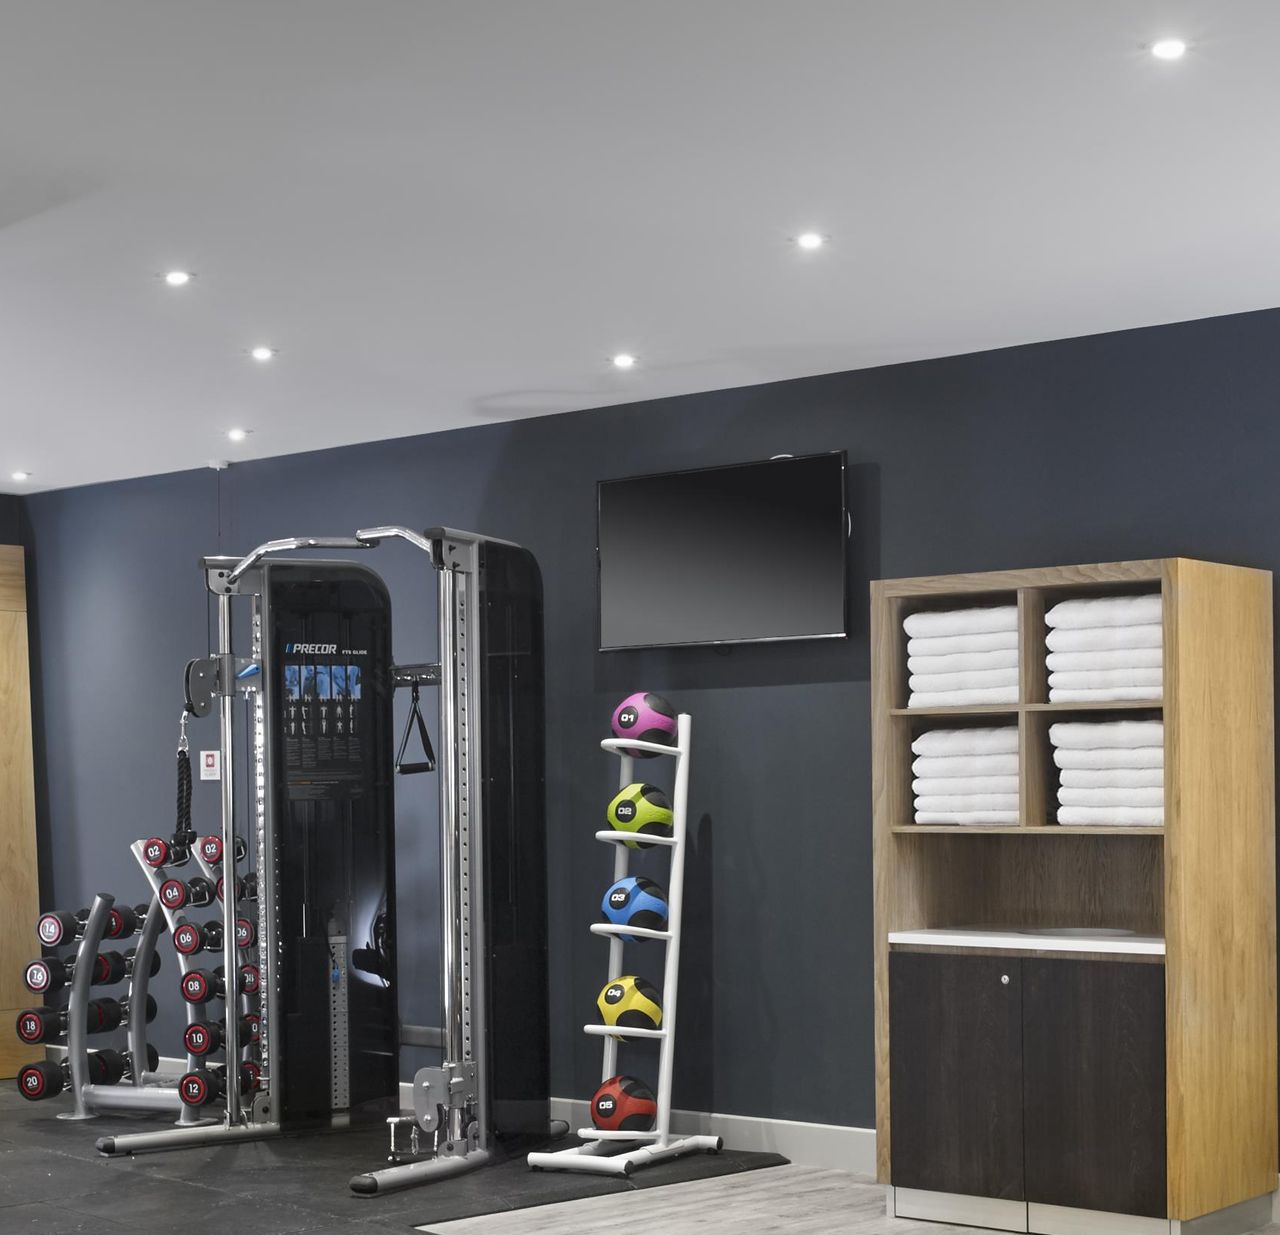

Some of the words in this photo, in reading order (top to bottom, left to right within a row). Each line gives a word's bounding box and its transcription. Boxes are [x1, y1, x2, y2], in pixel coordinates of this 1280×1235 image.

[292, 643, 337, 655] PRECOR
[621, 714, 635, 722] 01
[618, 807, 632, 815] 02
[147, 845, 161, 857] 02
[205, 843, 217, 854] 02
[166, 887, 179, 899] 04
[611, 893, 626, 902] 03
[44, 922, 55, 934] 14
[179, 932, 192, 944] 06
[32, 970, 44, 981] 16
[188, 981, 200, 991] 08
[607, 988, 621, 998] 04
[26, 1021, 36, 1031] 18
[192, 1033, 203, 1044] 10
[26, 1075, 38, 1087] 20
[188, 1083, 199, 1094] 12
[598, 1101, 613, 1110] 05
